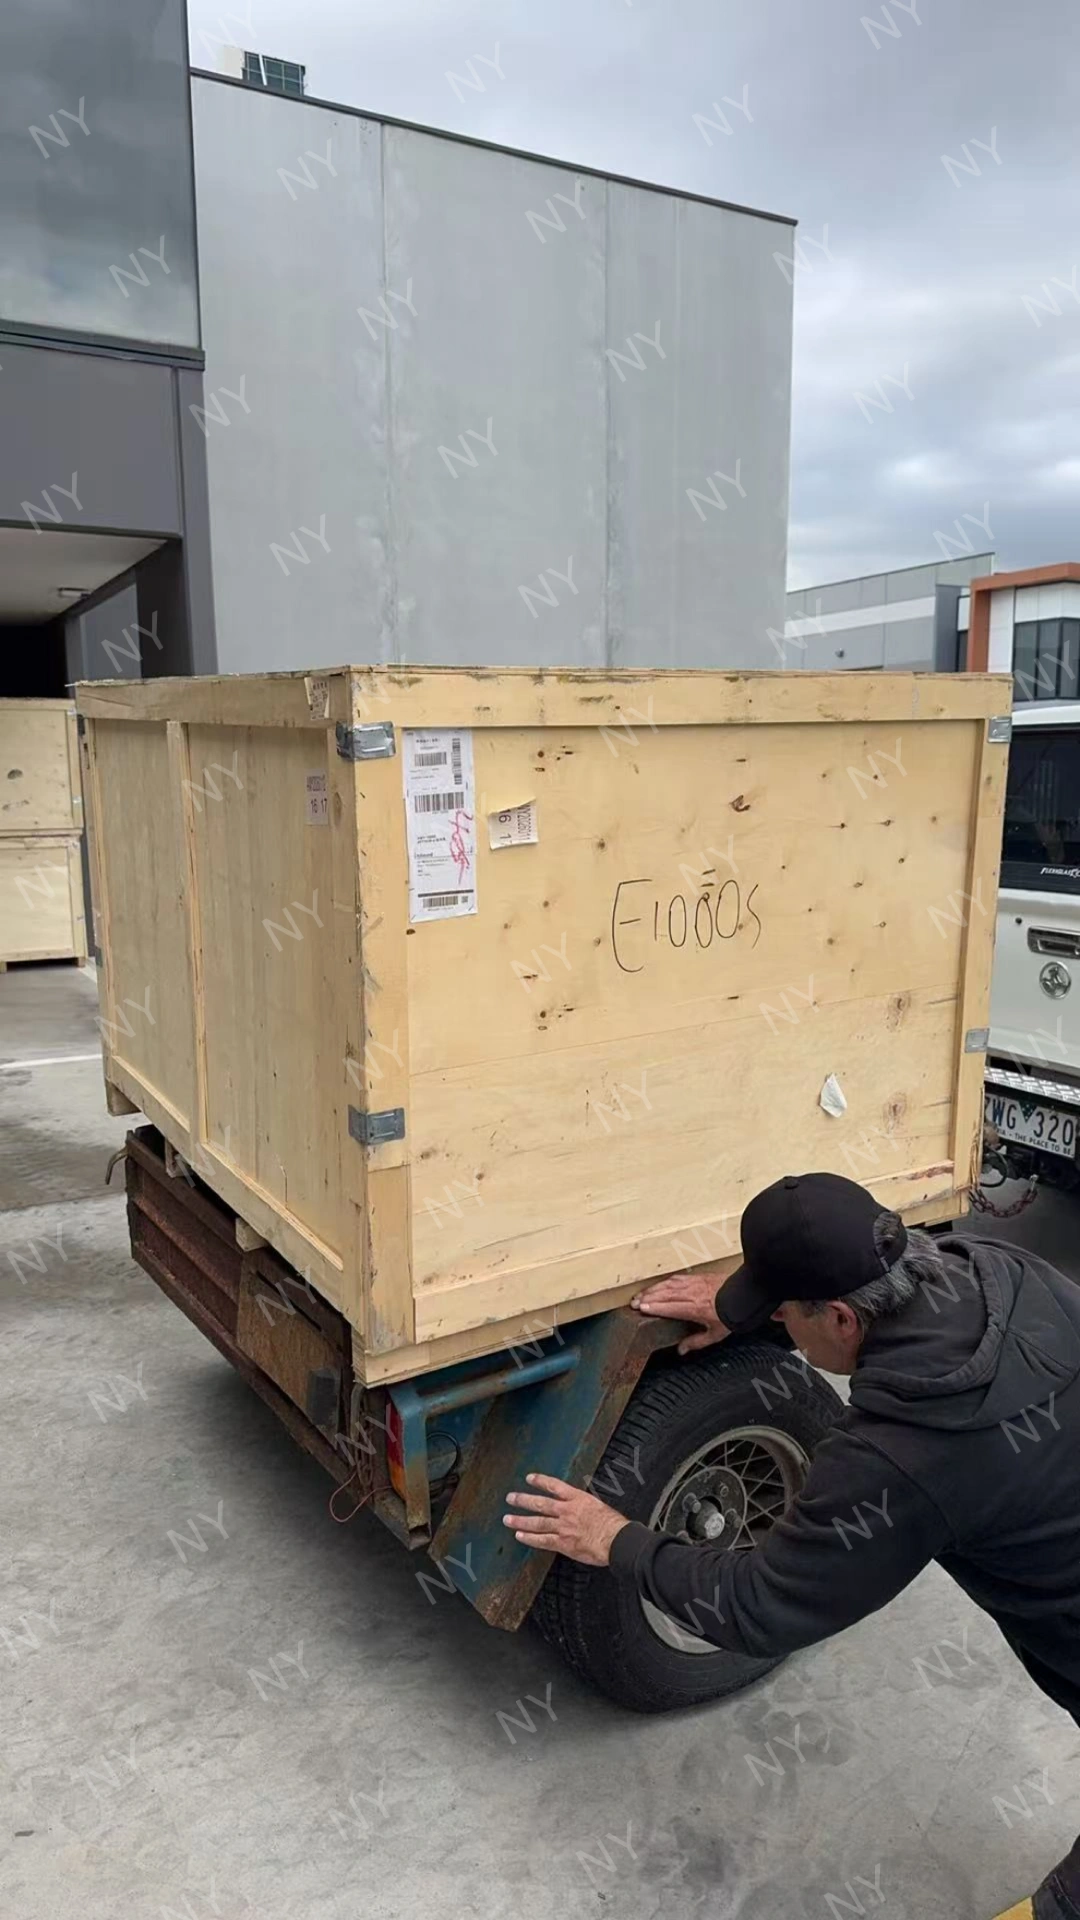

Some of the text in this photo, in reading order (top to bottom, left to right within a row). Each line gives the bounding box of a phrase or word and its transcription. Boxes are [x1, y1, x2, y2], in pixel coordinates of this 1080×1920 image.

[1014, 1132, 1026, 1142] THE
[1029, 1138, 1048, 1149] PLACE
[1051, 1143, 1060, 1152] TO
[1033, 1111, 1074, 1146] 320
